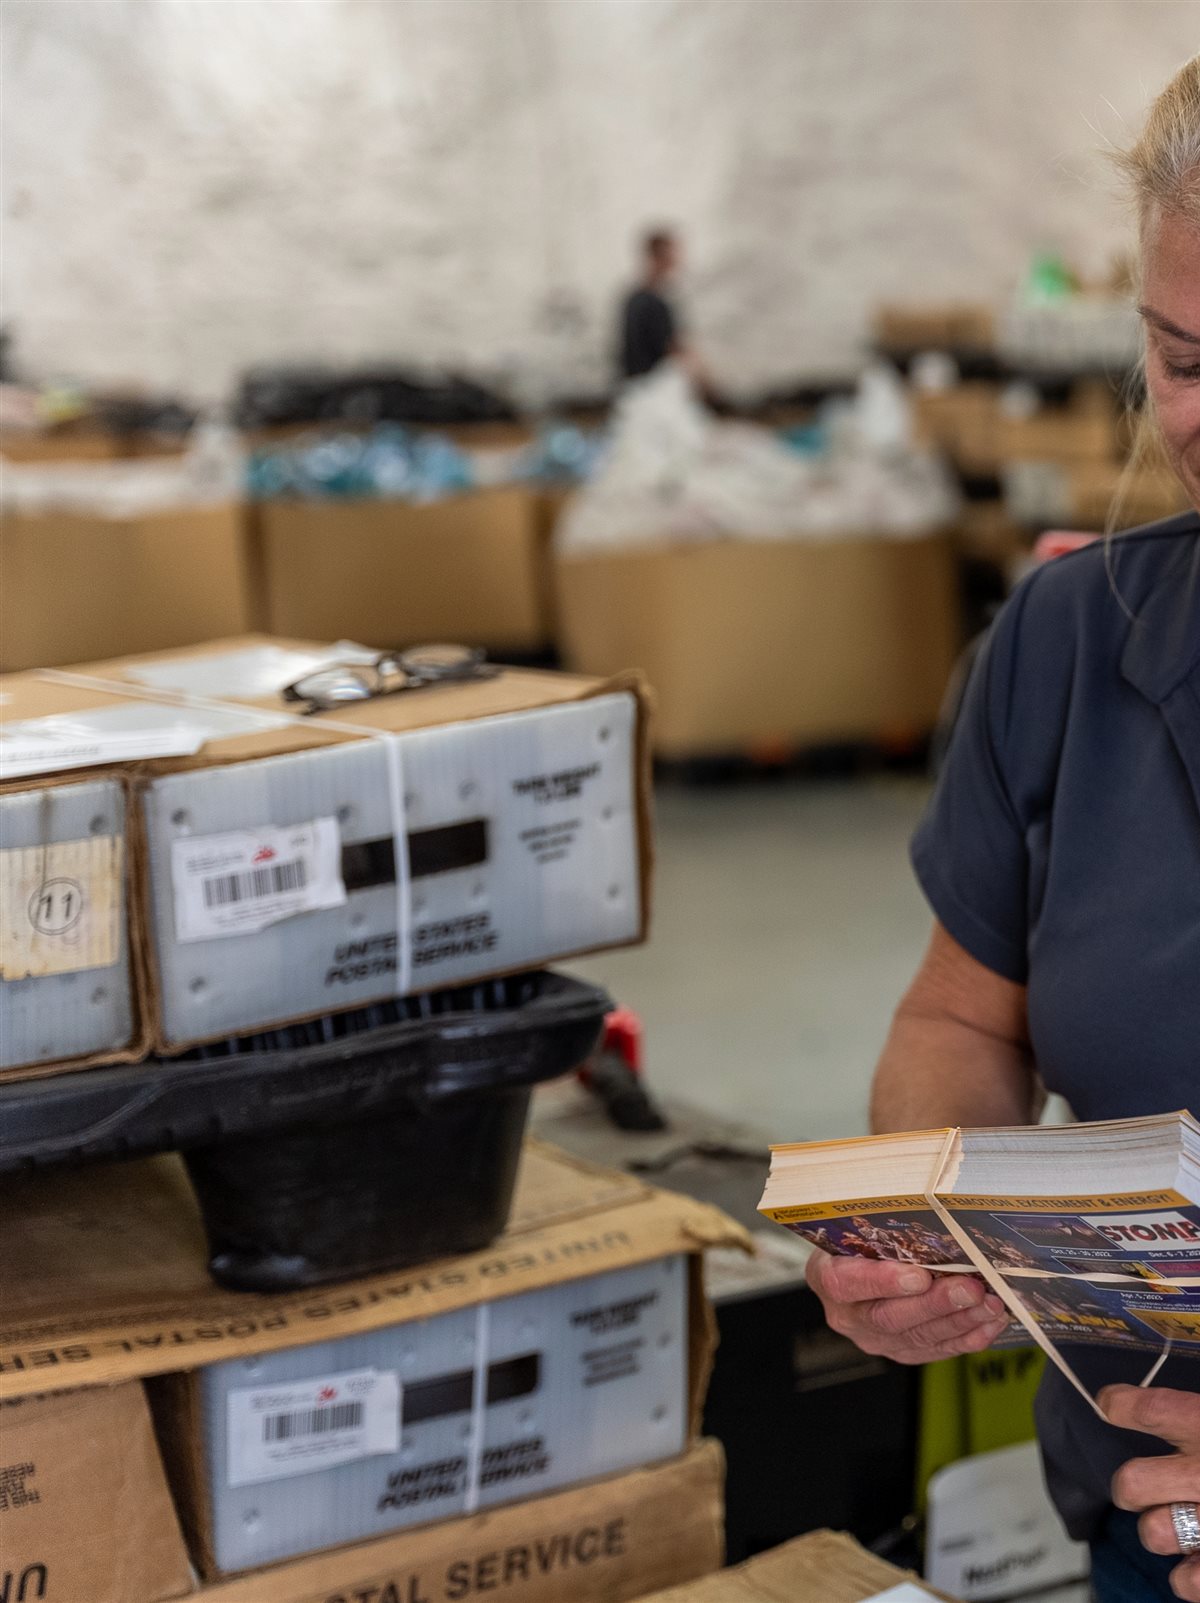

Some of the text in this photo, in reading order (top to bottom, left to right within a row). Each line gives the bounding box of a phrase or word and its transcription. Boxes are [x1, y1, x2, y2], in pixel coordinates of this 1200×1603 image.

[335, 931, 398, 963] UNITE
[324, 957, 398, 988] POSTA
[832, 1200, 906, 1212] EXPERIENCE
[1018, 1197, 1100, 1209] EXCITEMENT
[1099, 1198, 1110, 1207] &
[1111, 1193, 1175, 1207] ENERGY!
[105, 1313, 288, 1353] POSTAL
[445, 1516, 627, 1600] SERVICE
